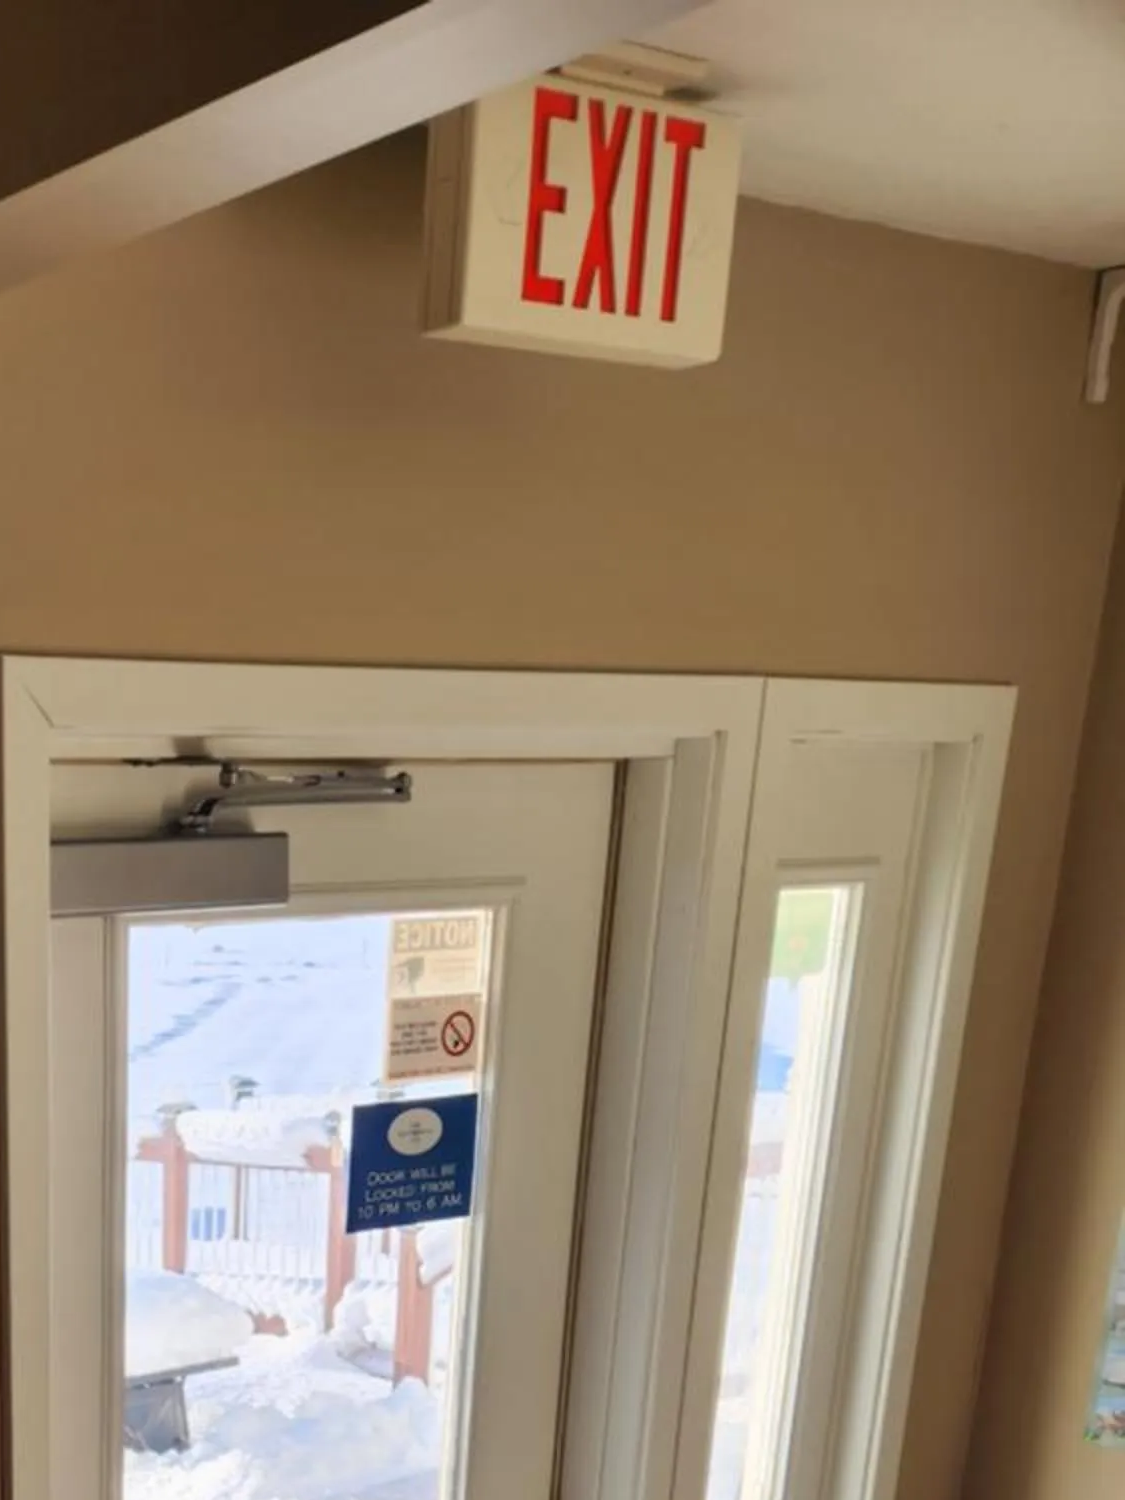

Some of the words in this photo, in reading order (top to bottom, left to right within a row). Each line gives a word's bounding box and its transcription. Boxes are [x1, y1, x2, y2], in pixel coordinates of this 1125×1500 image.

[521, 86, 707, 323] EXIT
[367, 1169, 405, 1186] DOOR
[410, 1166, 437, 1179] WILL
[365, 1184, 414, 1202] LOCKED
[420, 1179, 455, 1194] FROM
[357, 1204, 373, 1219] 10
[378, 1201, 399, 1215] PM
[405, 1199, 422, 1213] TO
[441, 1193, 463, 1208] AM
